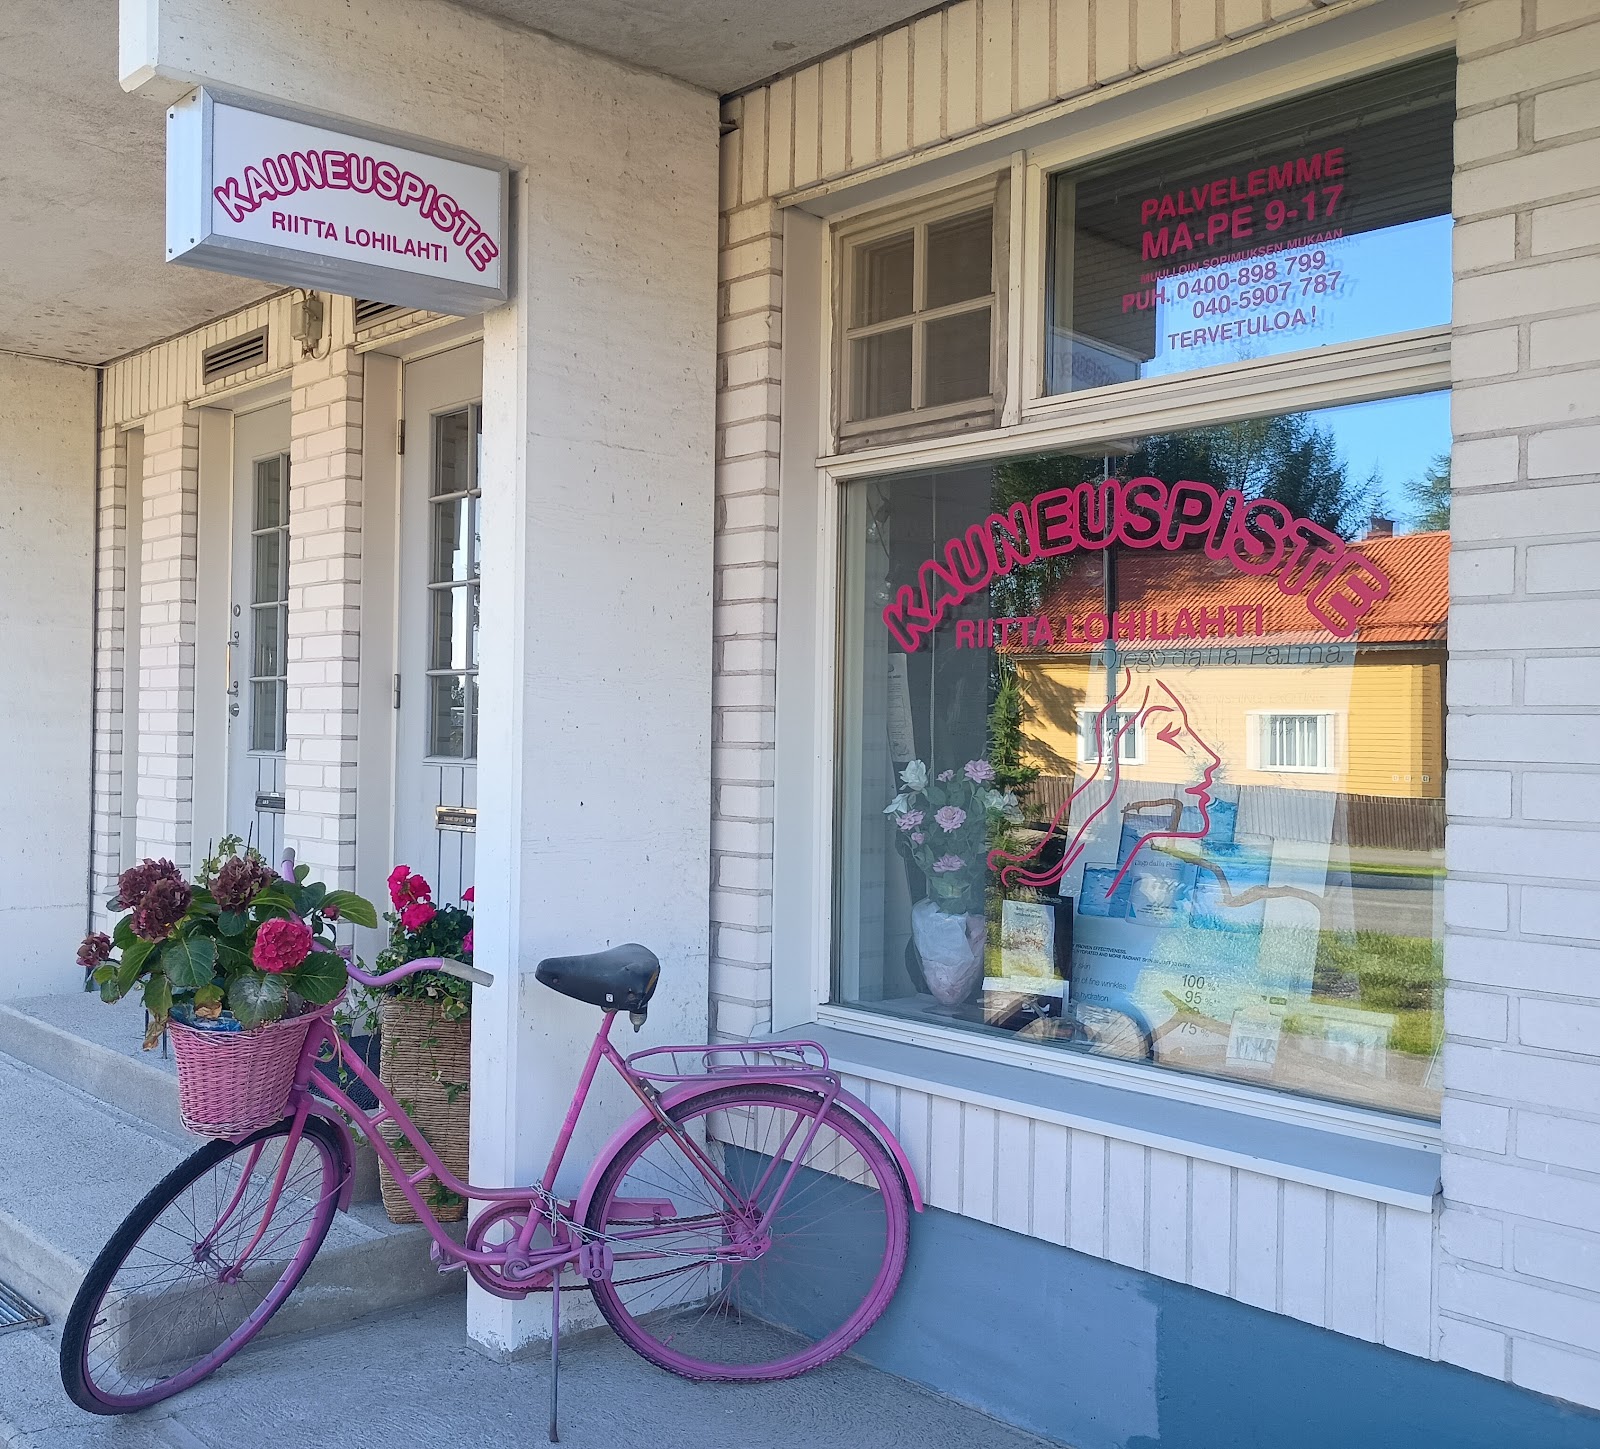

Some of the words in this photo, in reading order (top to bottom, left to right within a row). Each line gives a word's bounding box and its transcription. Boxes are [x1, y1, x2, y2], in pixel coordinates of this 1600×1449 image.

[1141, 147, 1345, 225] PALVELEMME
[213, 150, 499, 272] KAUNEUSPISTE
[1141, 206, 1253, 261] MA-PE
[1264, 184, 1344, 231] 9-17
[271, 211, 338, 241] RIITTA
[345, 226, 448, 263] LOHILAHTI
[1140, 261, 1200, 284] MUULLOIN
[1202, 242, 1283, 270] SOPIMUKSEN
[1286, 228, 1343, 250] MUKAAN
[1122, 286, 1171, 314] PUH.
[1177, 261, 1277, 300] 0400-898
[1285, 250, 1326, 276] 799
[1193, 280, 1290, 319] 040-5907
[1300, 271, 1342, 297] 787
[882, 477, 1390, 653] KAUNEUSPISTE
[955, 616, 1055, 649] RIITTA
[1066, 604, 1264, 644] LOHILAHTI
[1102, 649, 1166, 673] Diego
[1172, 646, 1241, 667] dalla
[1250, 643, 1344, 665] Palma
[1080, 992, 1109, 1002] hydration
[1089, 978, 1100, 987] fine
[1101, 981, 1127, 990] wrinkles
[1181, 974, 1205, 990] 100
[1184, 990, 1202, 1005] 95
[1180, 1022, 1198, 1036] 75
